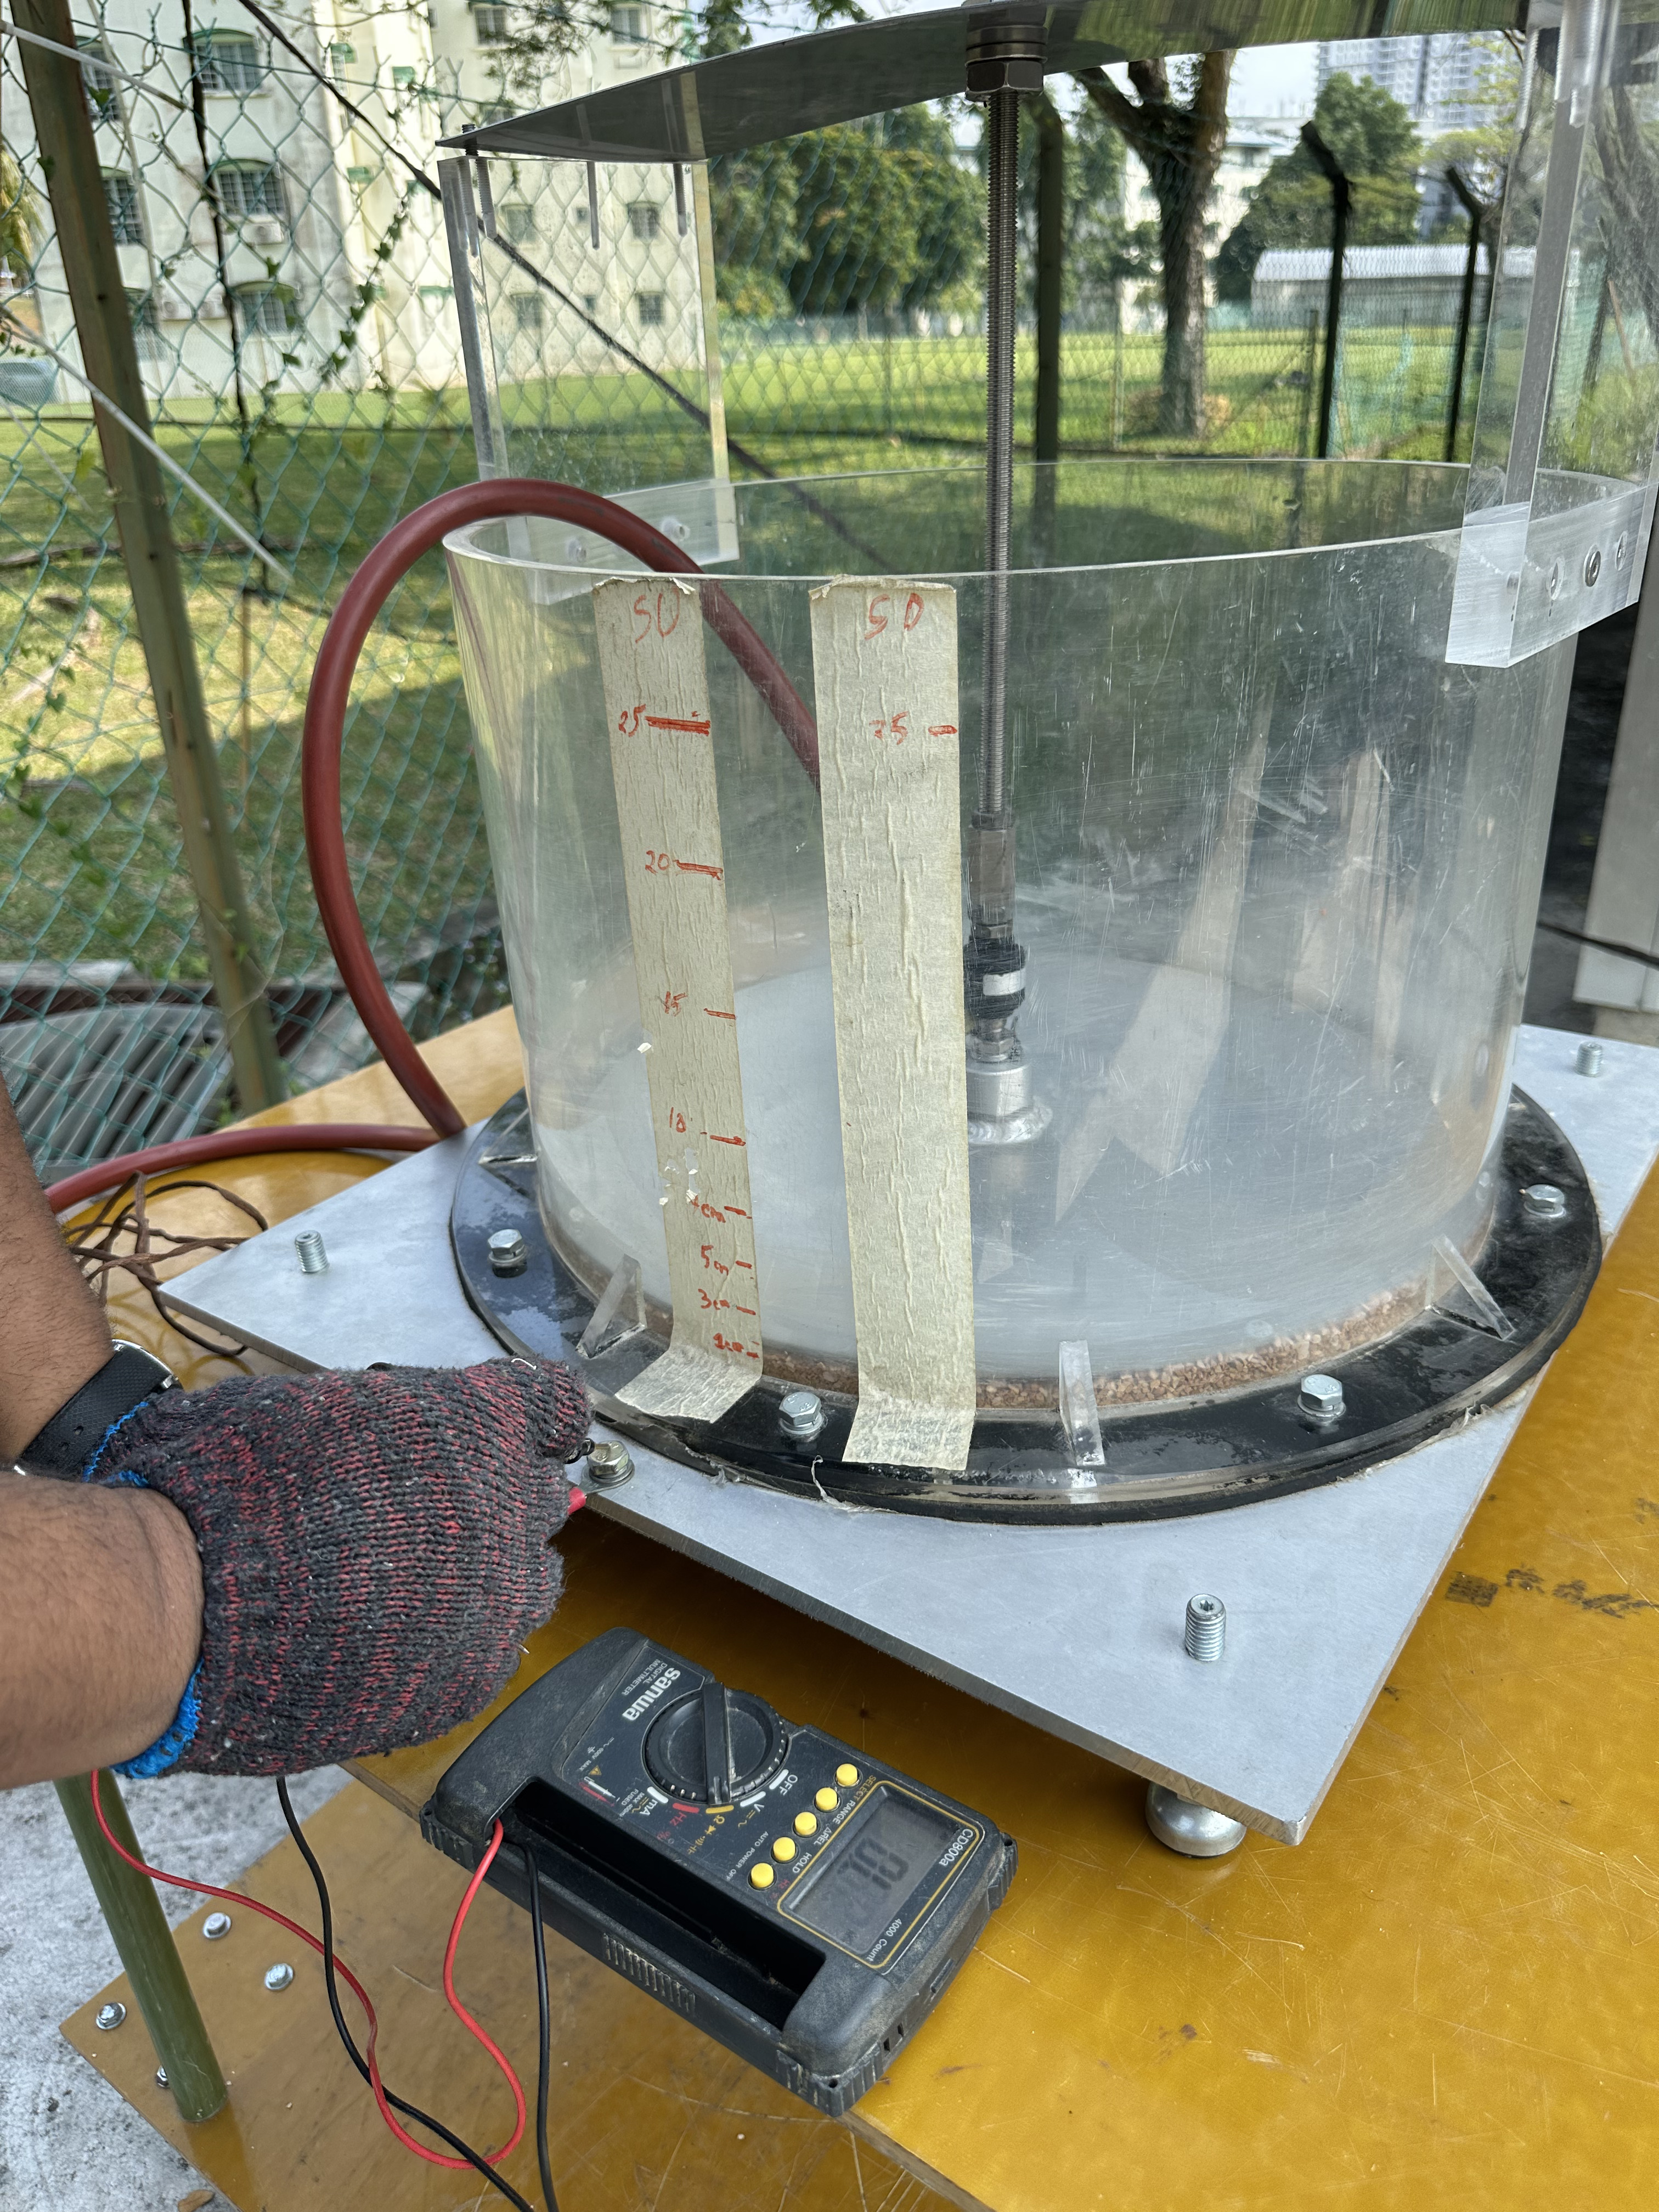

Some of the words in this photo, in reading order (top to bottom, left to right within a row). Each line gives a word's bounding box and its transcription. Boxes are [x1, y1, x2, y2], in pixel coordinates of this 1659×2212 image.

[618, 704, 646, 737] 25
[644, 850, 669, 874] 20
[669, 1107, 686, 1132] 10
[621, 1659, 661, 1695] MULTIMETER
[642, 1662, 667, 1684] DIGITAL
[622, 1668, 680, 1720] sanwa
[579, 1760, 591, 1771] MAX
[778, 1774, 798, 1795] OFF
[853, 1775, 876, 1801] SELECT
[621, 1788, 639, 1805] FUSED
[640, 1798, 657, 1815] mA
[832, 1799, 855, 1825] RANGE
[754, 1831, 768, 1846] AUTO
[938, 1828, 973, 1866] CD800a
[736, 1847, 755, 1867] POWER
[792, 1852, 811, 1873] HOLD
[725, 1869, 736, 1881] OFF
[885, 1918, 902, 1937] 4000
[866, 1938, 887, 1962] Count
